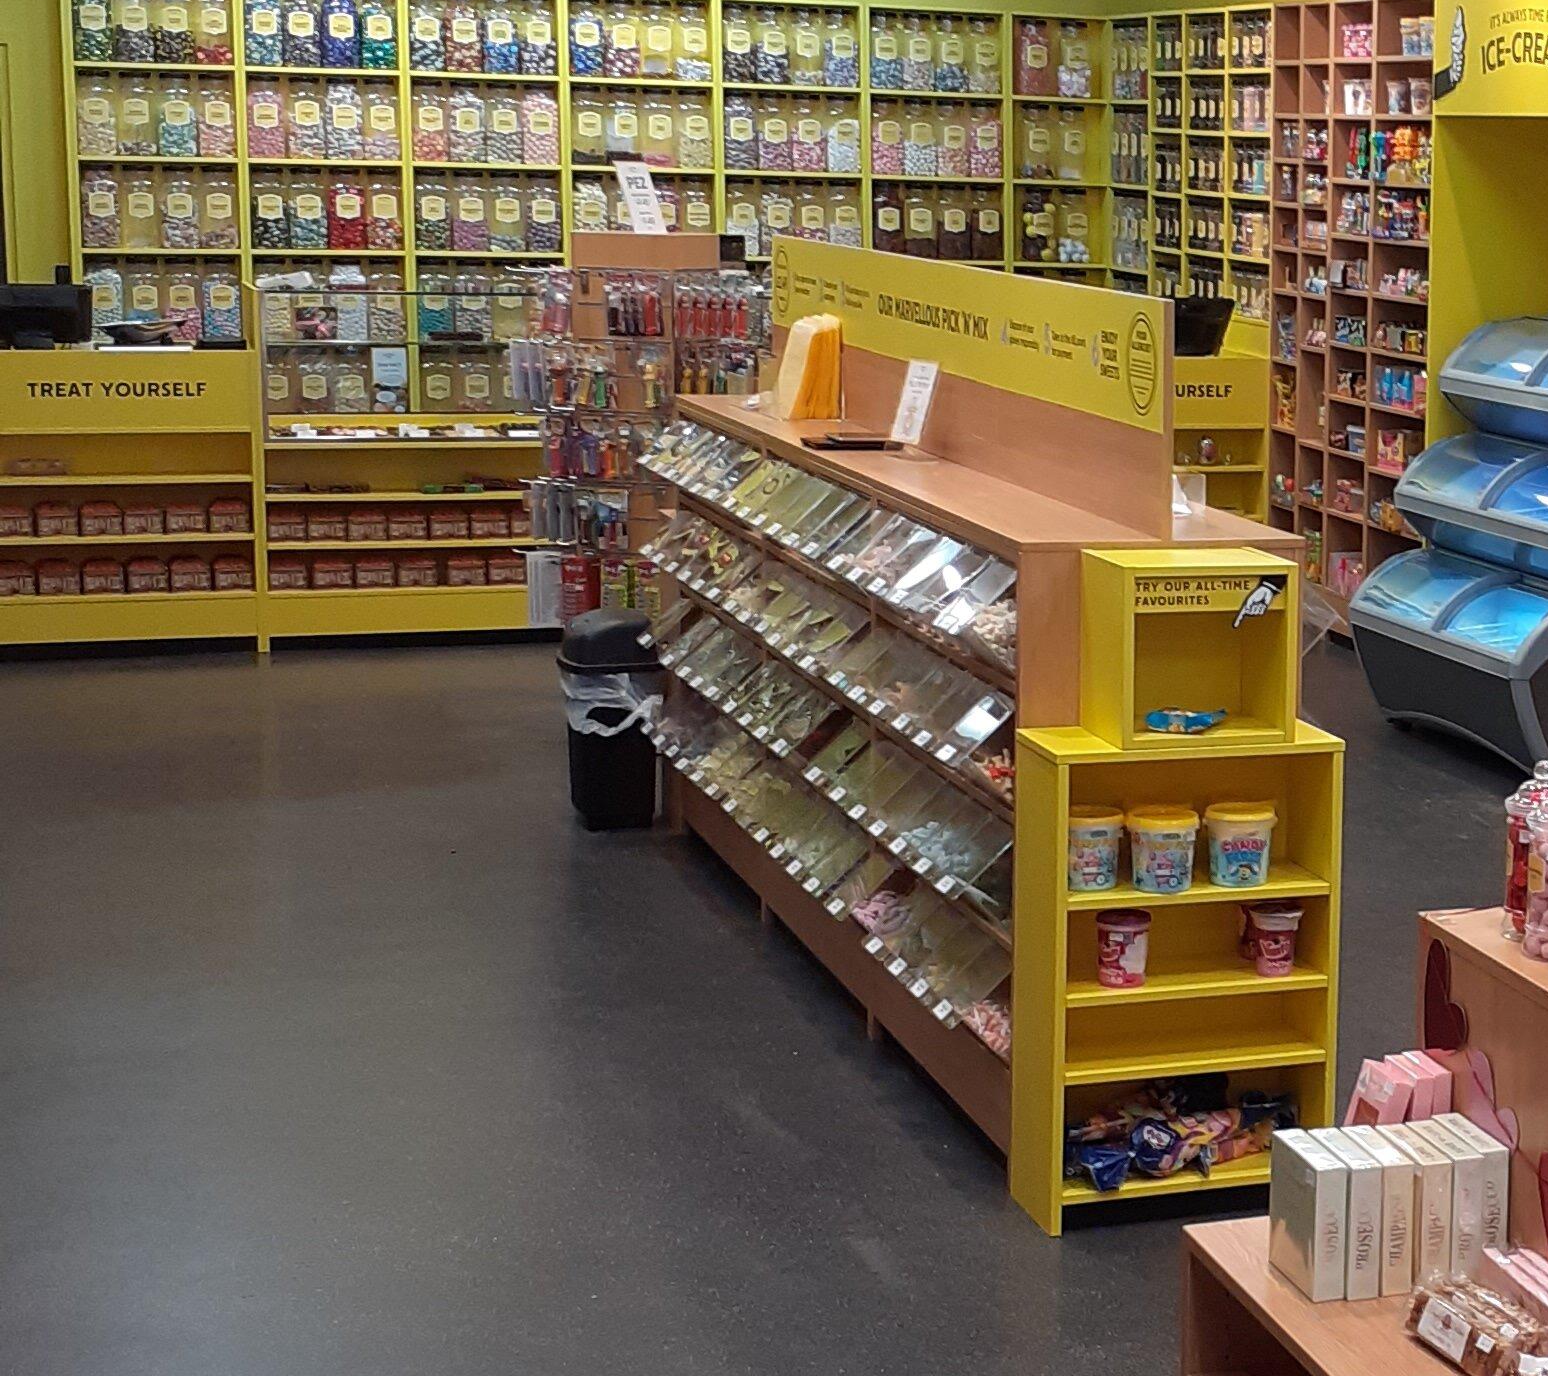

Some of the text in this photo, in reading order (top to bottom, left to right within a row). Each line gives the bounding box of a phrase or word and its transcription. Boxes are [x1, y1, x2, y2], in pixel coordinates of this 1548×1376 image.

[878, 293, 894, 316] OUR
[972, 315, 989, 340] MIX
[27, 382, 207, 398] TREAT YOURSELF
[1174, 384, 1233, 398] URSELF
[1135, 580, 1250, 592] TRY OUR ALL-TIME
[1135, 595, 1210, 606] FAVOURITES
